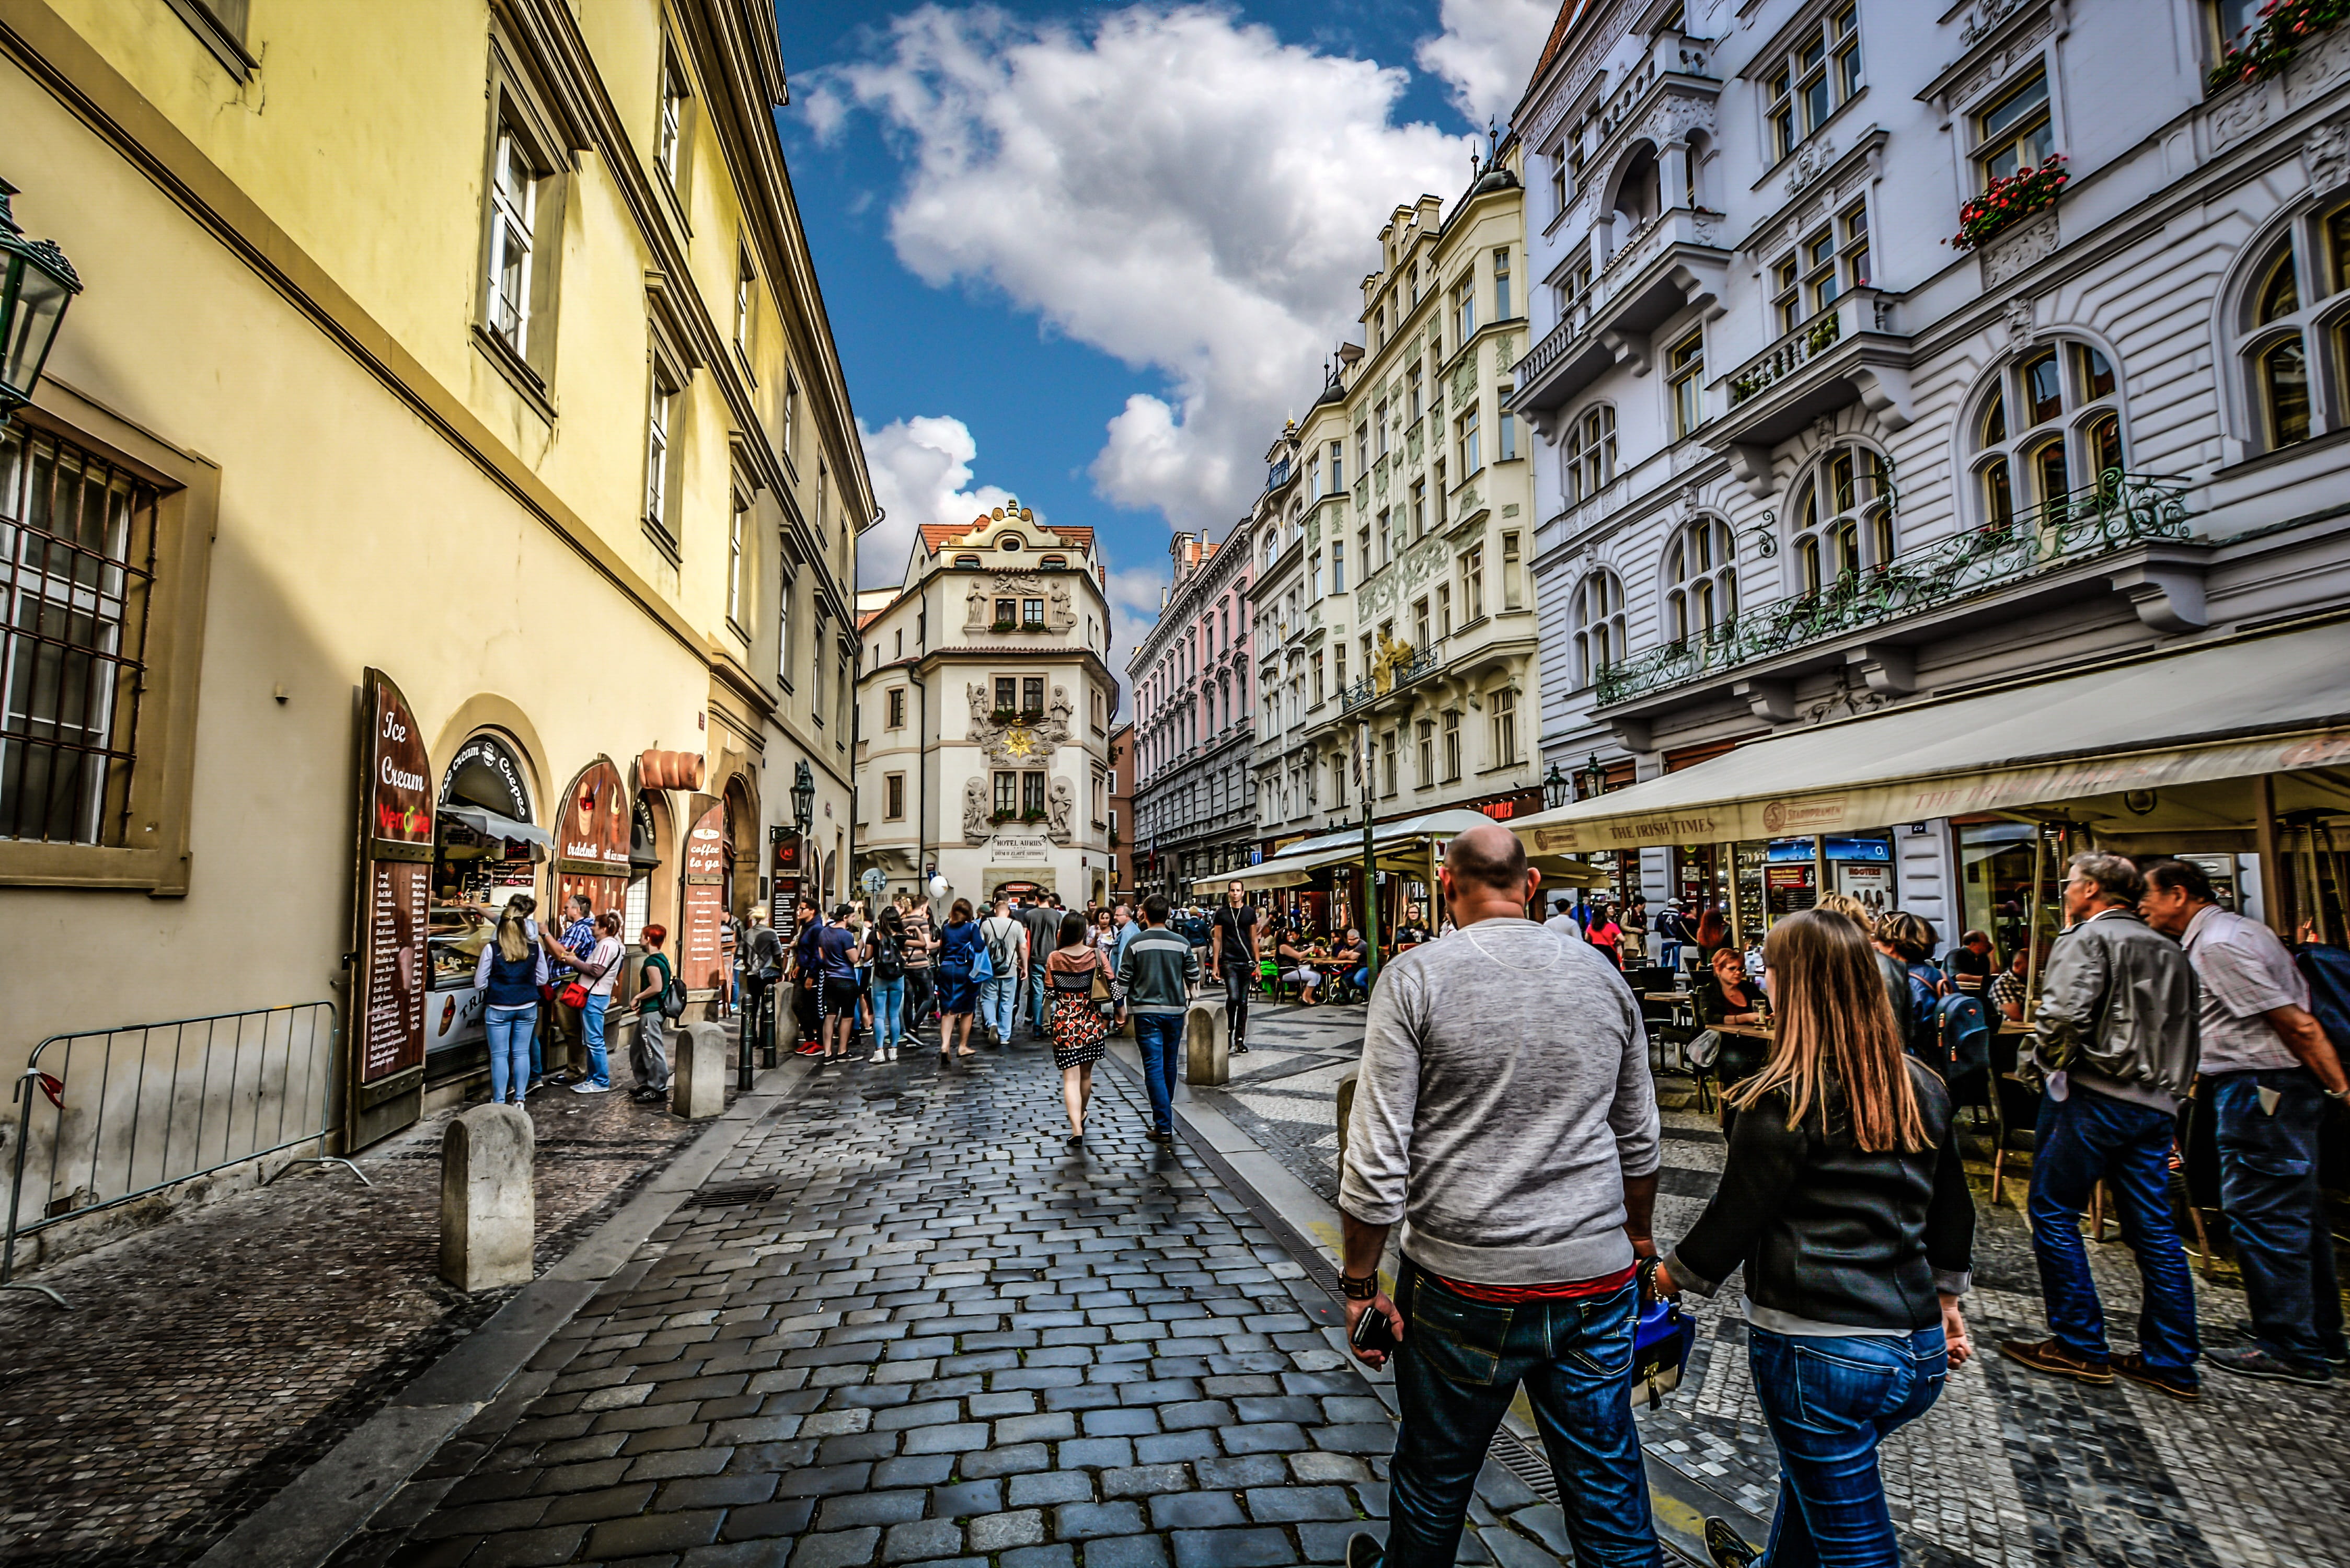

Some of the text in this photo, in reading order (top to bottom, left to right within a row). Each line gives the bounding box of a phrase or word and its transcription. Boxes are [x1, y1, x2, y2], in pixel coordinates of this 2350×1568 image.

[383, 711, 406, 743] Ice
[382, 756, 424, 792] Cream
[439, 770, 452, 803] Ice
[499, 757, 525, 816] Crepes
[1915, 789, 1962, 810] THE
[1609, 817, 1715, 839] THE IRISH TIMES
[690, 844, 720, 856] coffee
[689, 857, 720, 871] to go
[1665, 915, 1674, 925] 4
